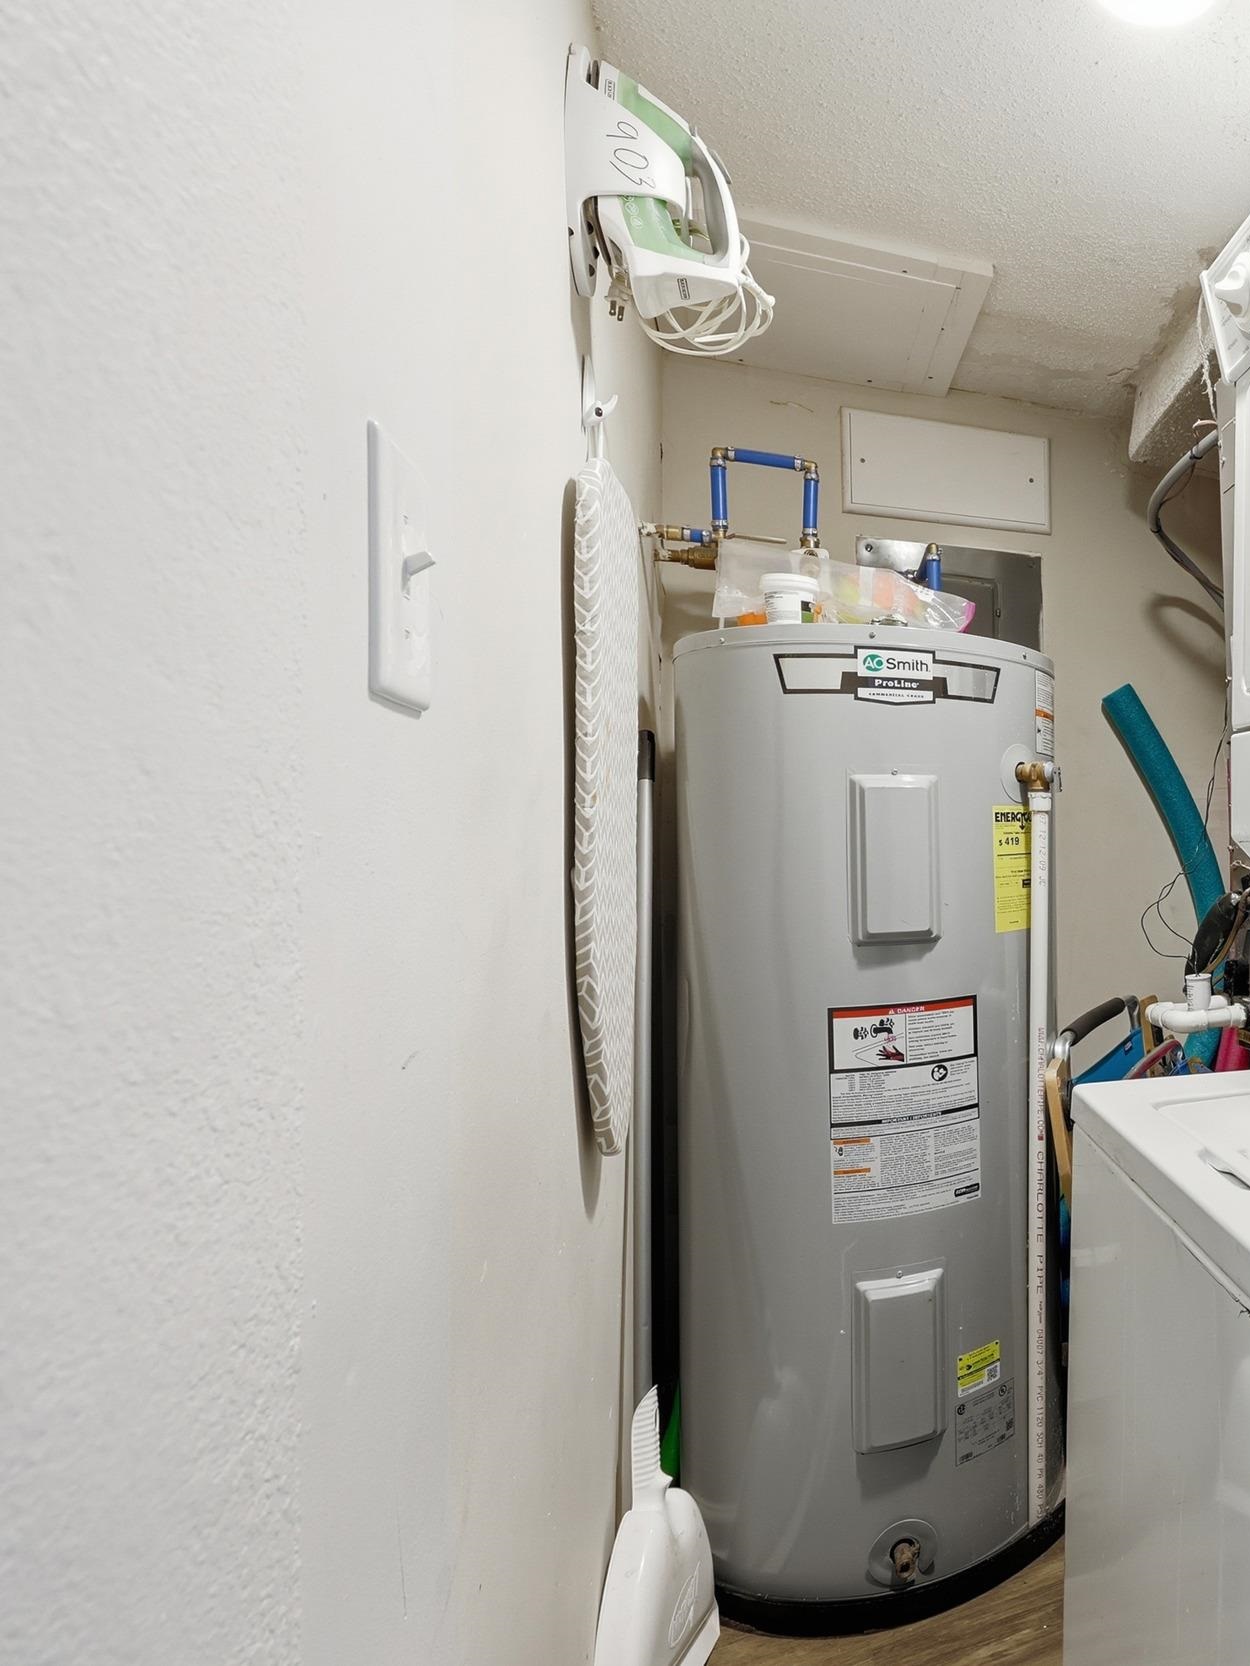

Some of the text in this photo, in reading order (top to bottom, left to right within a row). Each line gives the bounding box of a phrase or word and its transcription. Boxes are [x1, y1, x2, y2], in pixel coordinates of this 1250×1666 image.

[606, 121, 656, 189] 903
[886, 658, 929, 672] Smith
[874, 679, 918, 689] ProLine
[1004, 836, 1020, 846] 419
[897, 1005, 925, 1014] DANGER
[1036, 1151, 1045, 1243] CHARLOTTE
[1036, 1254, 1044, 1294] PIPE
[1036, 1406, 1044, 1427] 1120
[1036, 1453, 1044, 1464] 40
